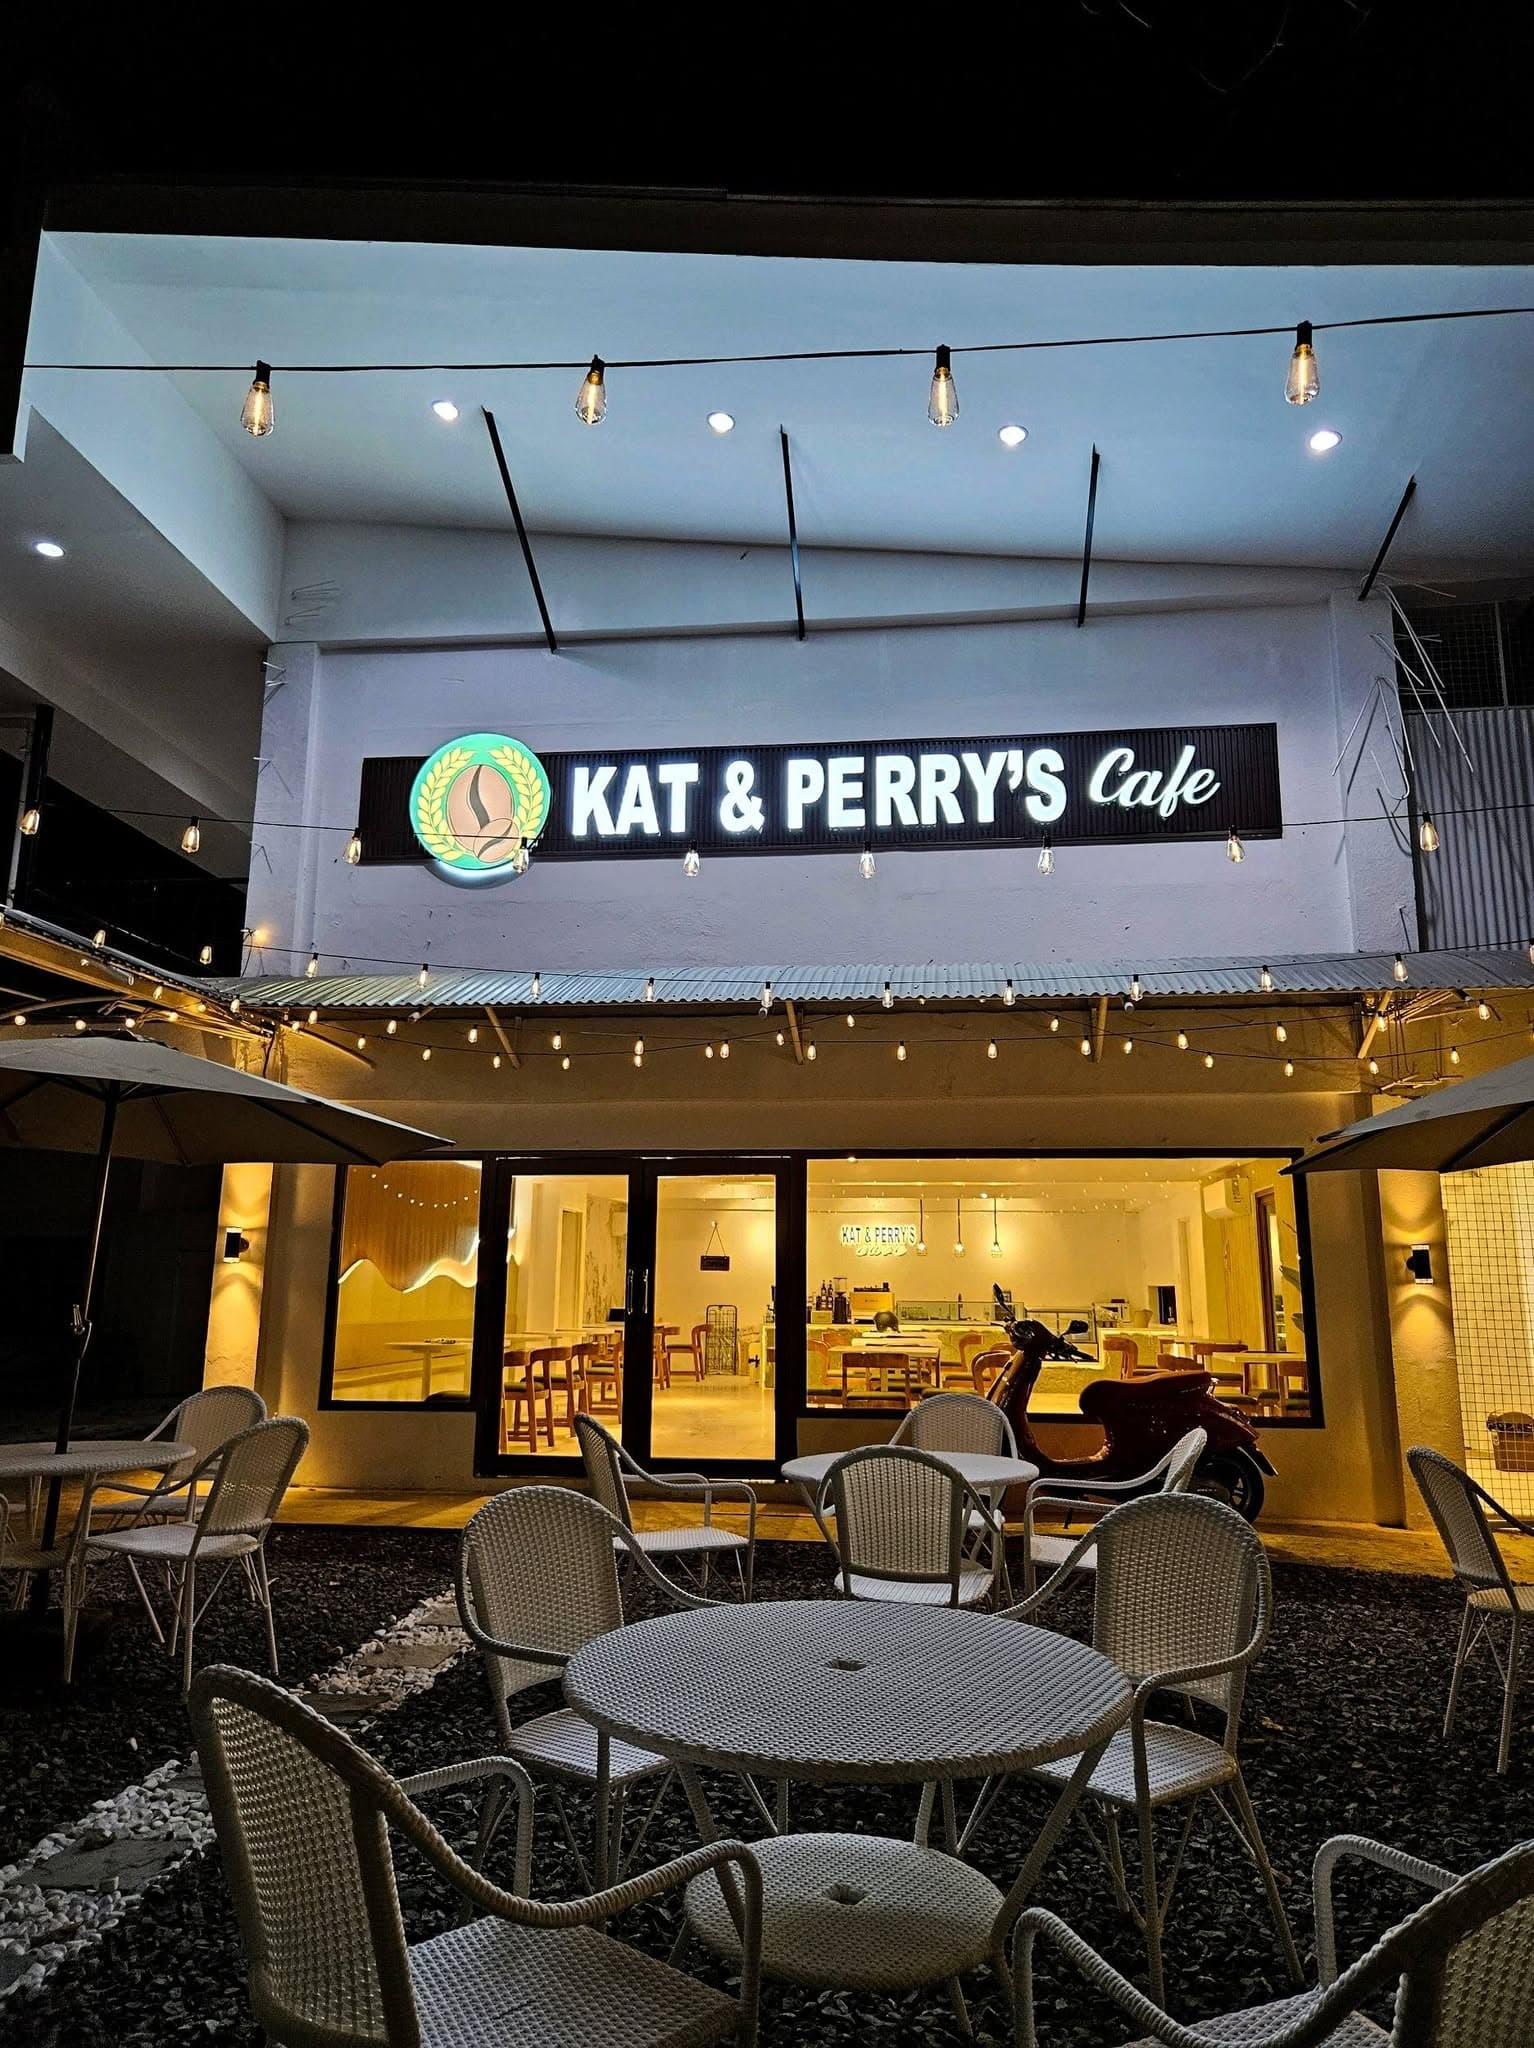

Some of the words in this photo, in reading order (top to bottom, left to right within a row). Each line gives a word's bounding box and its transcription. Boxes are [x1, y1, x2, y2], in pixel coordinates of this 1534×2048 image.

[571, 763, 699, 836] KAT
[719, 760, 765, 833] &
[787, 749, 1067, 830] PERRY'S
[1089, 745, 1221, 818] Cafe
[842, 1226, 861, 1243] KAT
[864, 1226, 873, 1243] &
